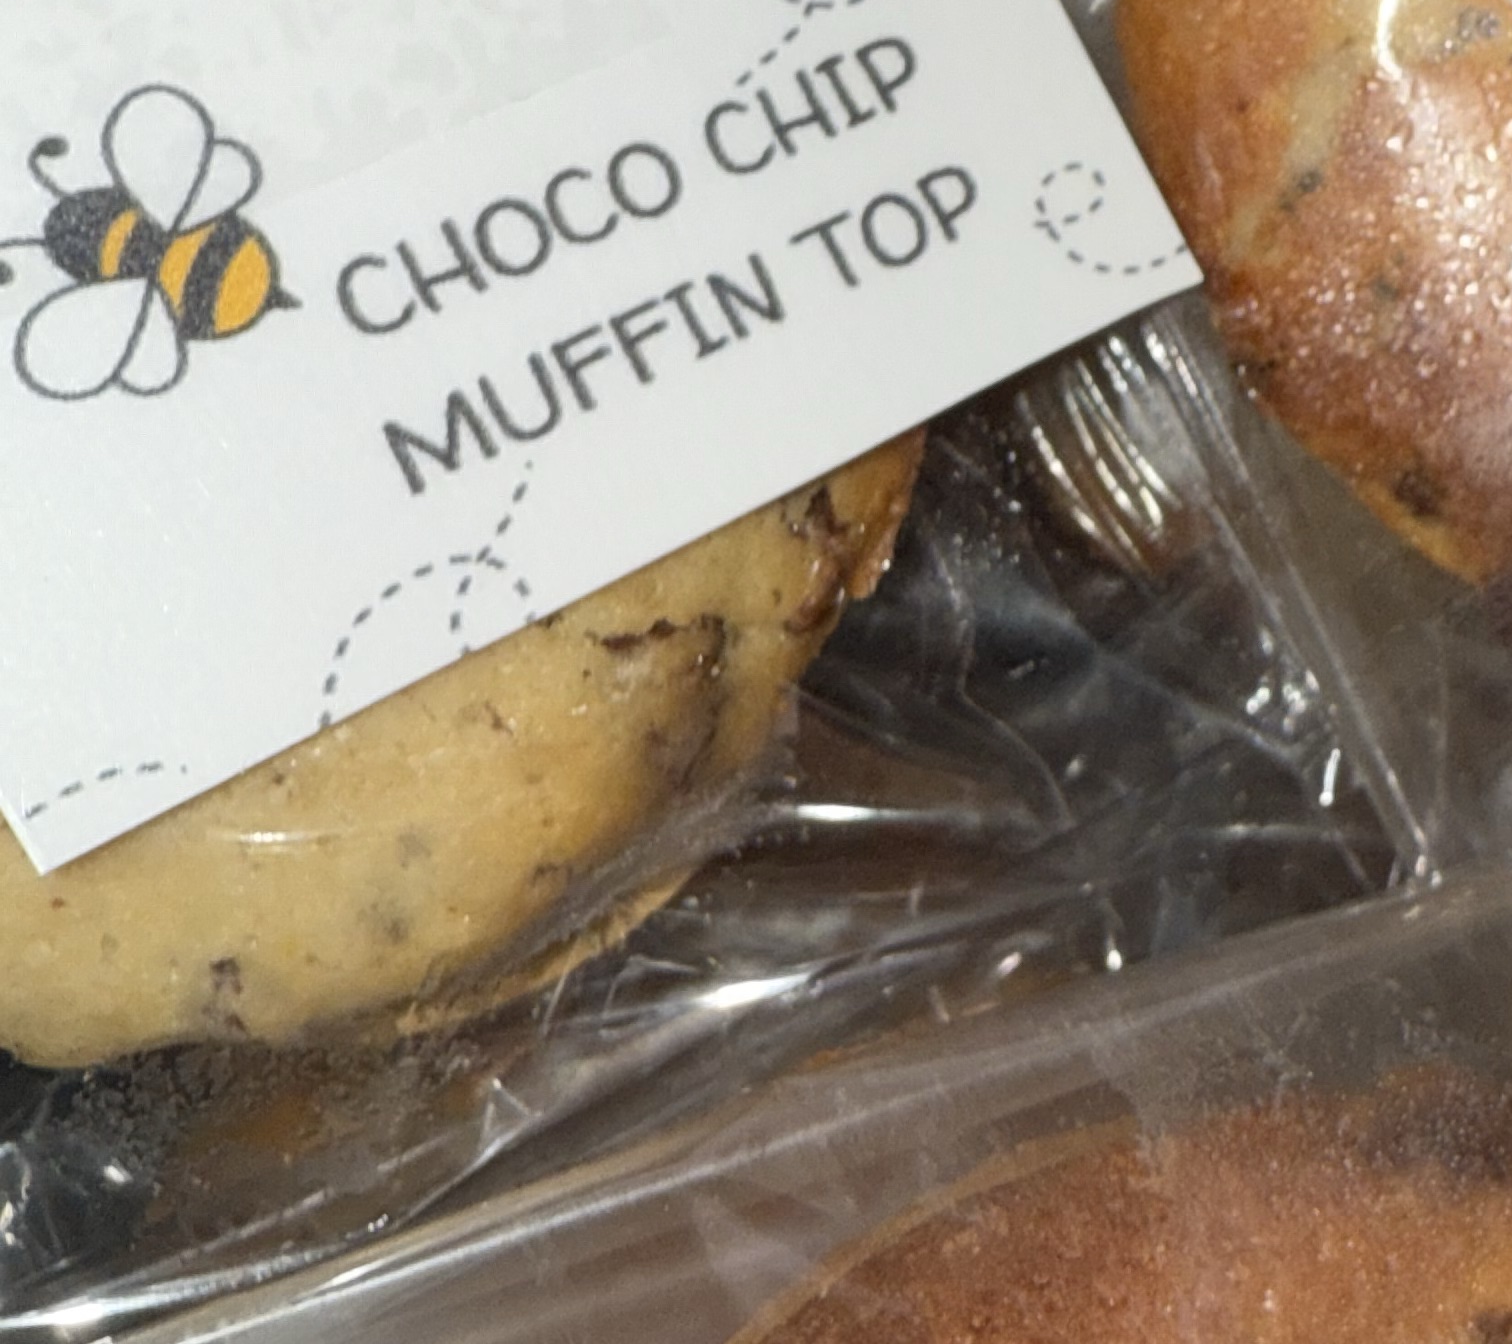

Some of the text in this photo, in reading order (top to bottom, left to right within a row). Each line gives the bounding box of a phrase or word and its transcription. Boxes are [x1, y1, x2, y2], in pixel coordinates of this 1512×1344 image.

[336, 35, 917, 335] CHOCO CHIP
[382, 166, 977, 496] MUFFIN TOP
